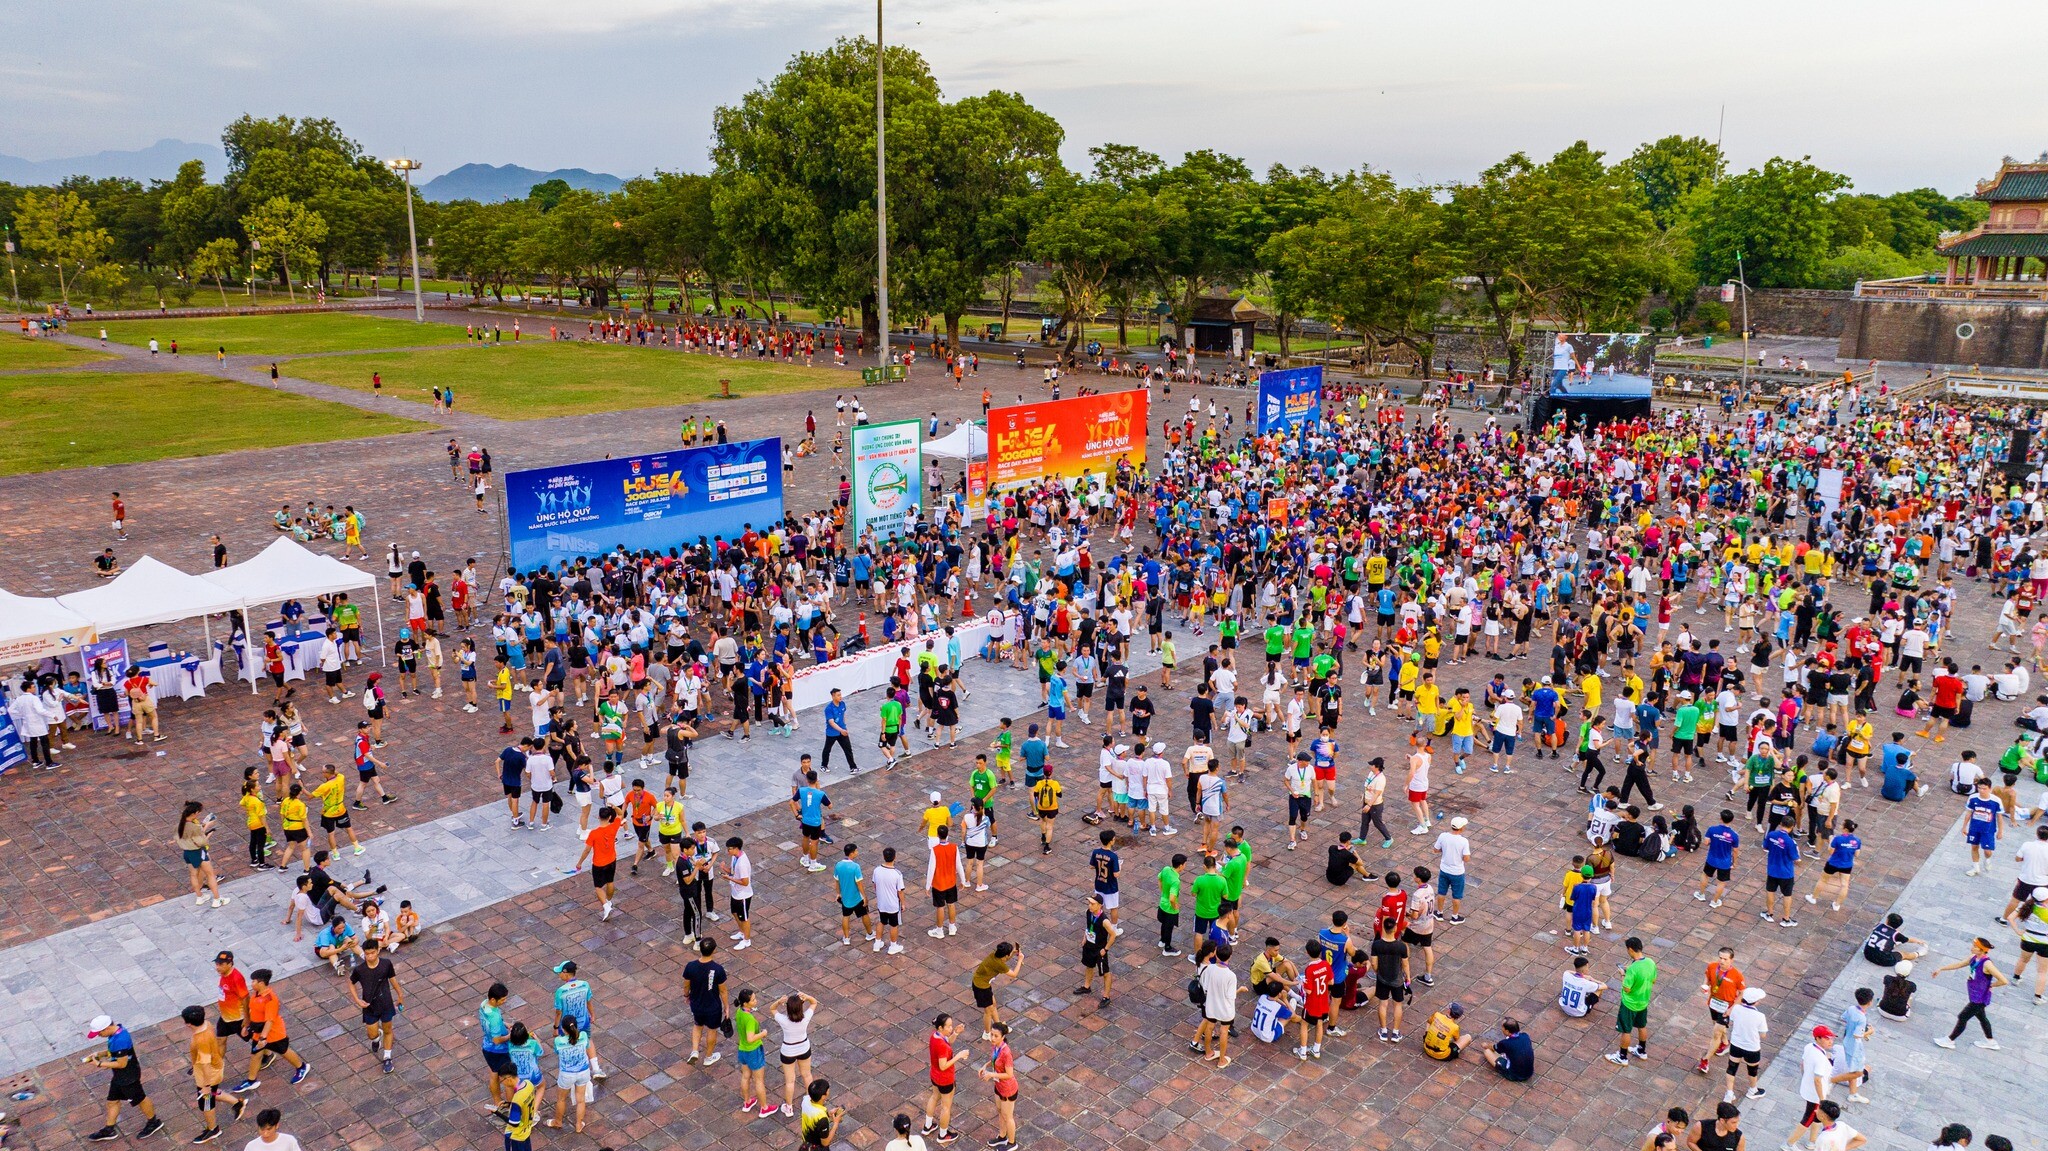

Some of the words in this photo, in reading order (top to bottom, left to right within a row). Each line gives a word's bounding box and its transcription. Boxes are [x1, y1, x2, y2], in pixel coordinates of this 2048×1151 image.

[997, 427, 1043, 453] HUE
[1102, 437, 1114, 448] HỘ
[1115, 434, 1129, 447] QUỸ
[998, 447, 1043, 462] JOGGING
[623, 473, 669, 495] HUE
[625, 489, 670, 502] JOGGING
[558, 509, 570, 520] HỘ
[573, 506, 591, 518] QUỸ
[879, 514, 889, 522] MỘT
[546, 529, 600, 554] FINISHER
[1372, 563, 1383, 573] 54
[625, 573, 631, 582] 2
[517, 592, 523, 602] 9
[990, 617, 999, 625] 47
[1591, 819, 1606, 835] 21
[1097, 860, 1109, 879] 15
[1868, 933, 1888, 952] 24
[1325, 949, 1333, 966] 6
[1314, 974, 1327, 996] 13
[1562, 985, 1581, 1009] 99
[1252, 1008, 1268, 1032] 91
